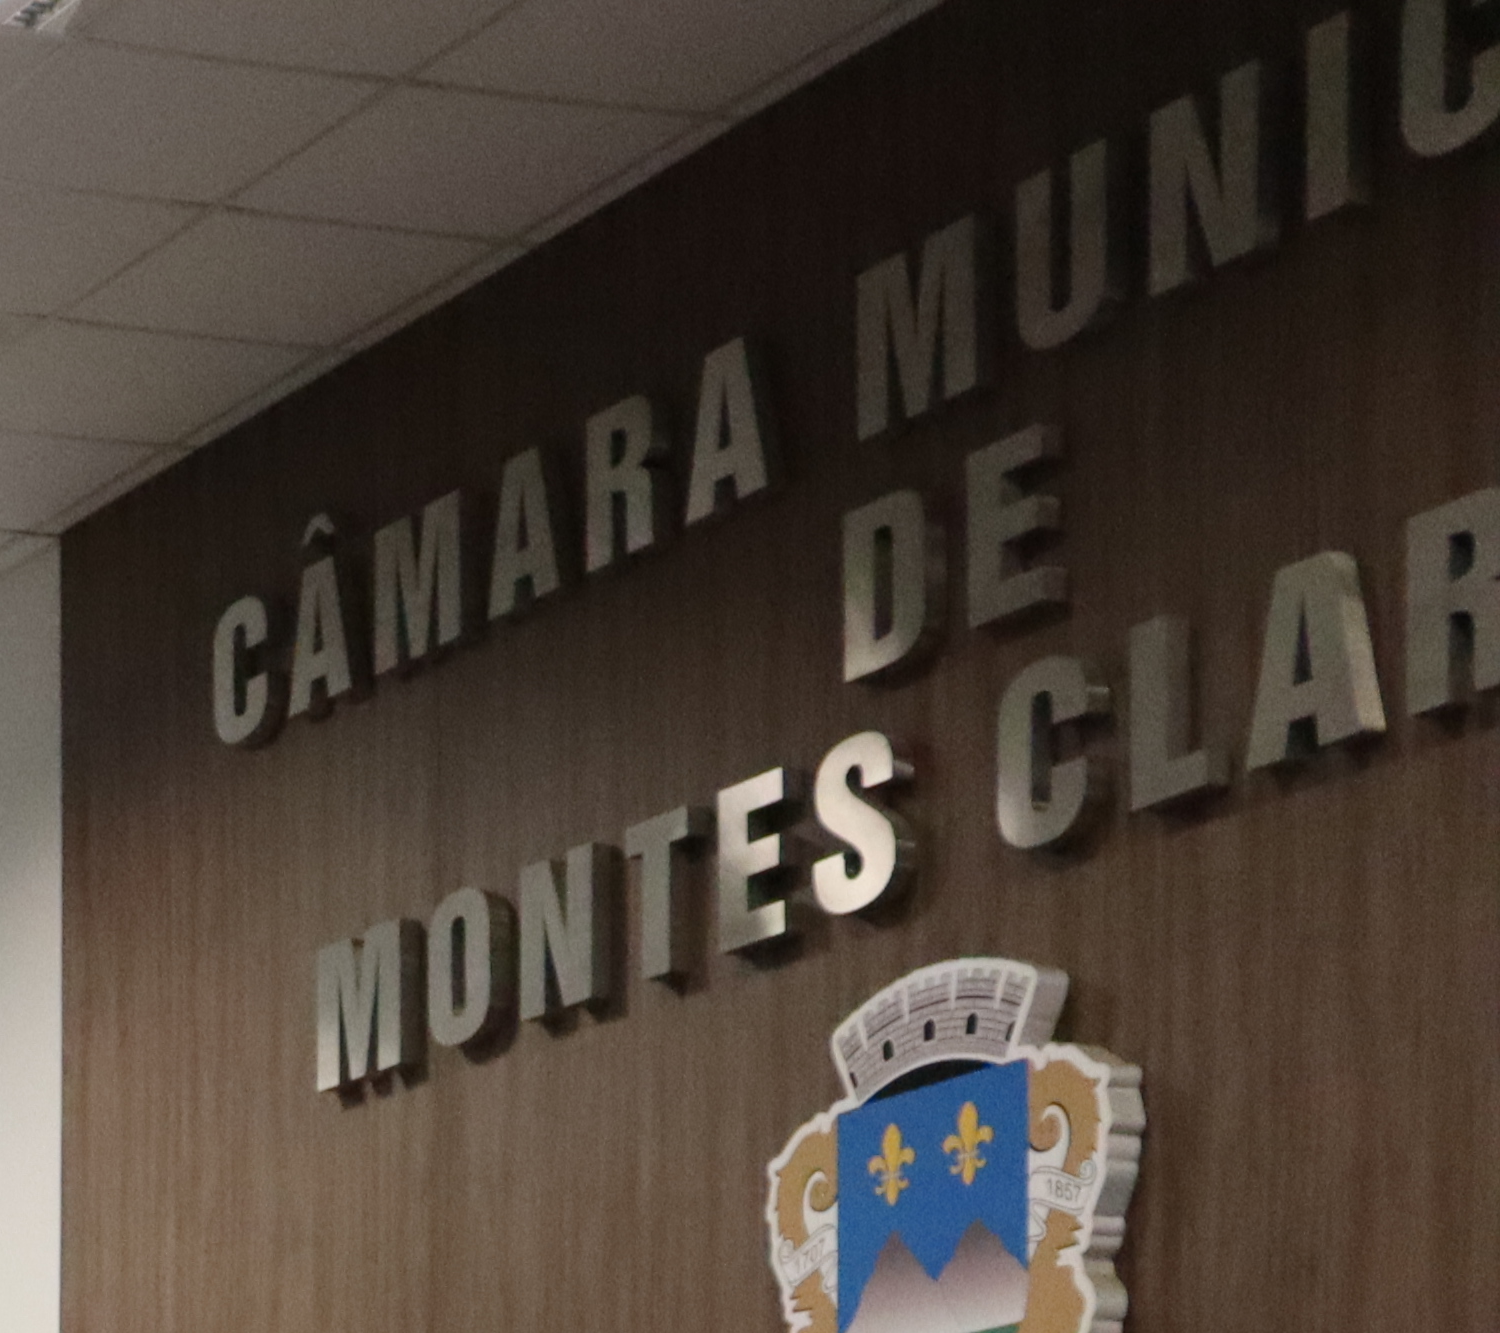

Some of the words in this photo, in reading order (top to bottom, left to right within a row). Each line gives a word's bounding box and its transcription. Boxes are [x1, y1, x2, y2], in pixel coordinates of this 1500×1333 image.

[212, 335, 774, 748] CÂMARA
[841, 424, 1064, 686] DE
[315, 730, 902, 1094] MONTES
